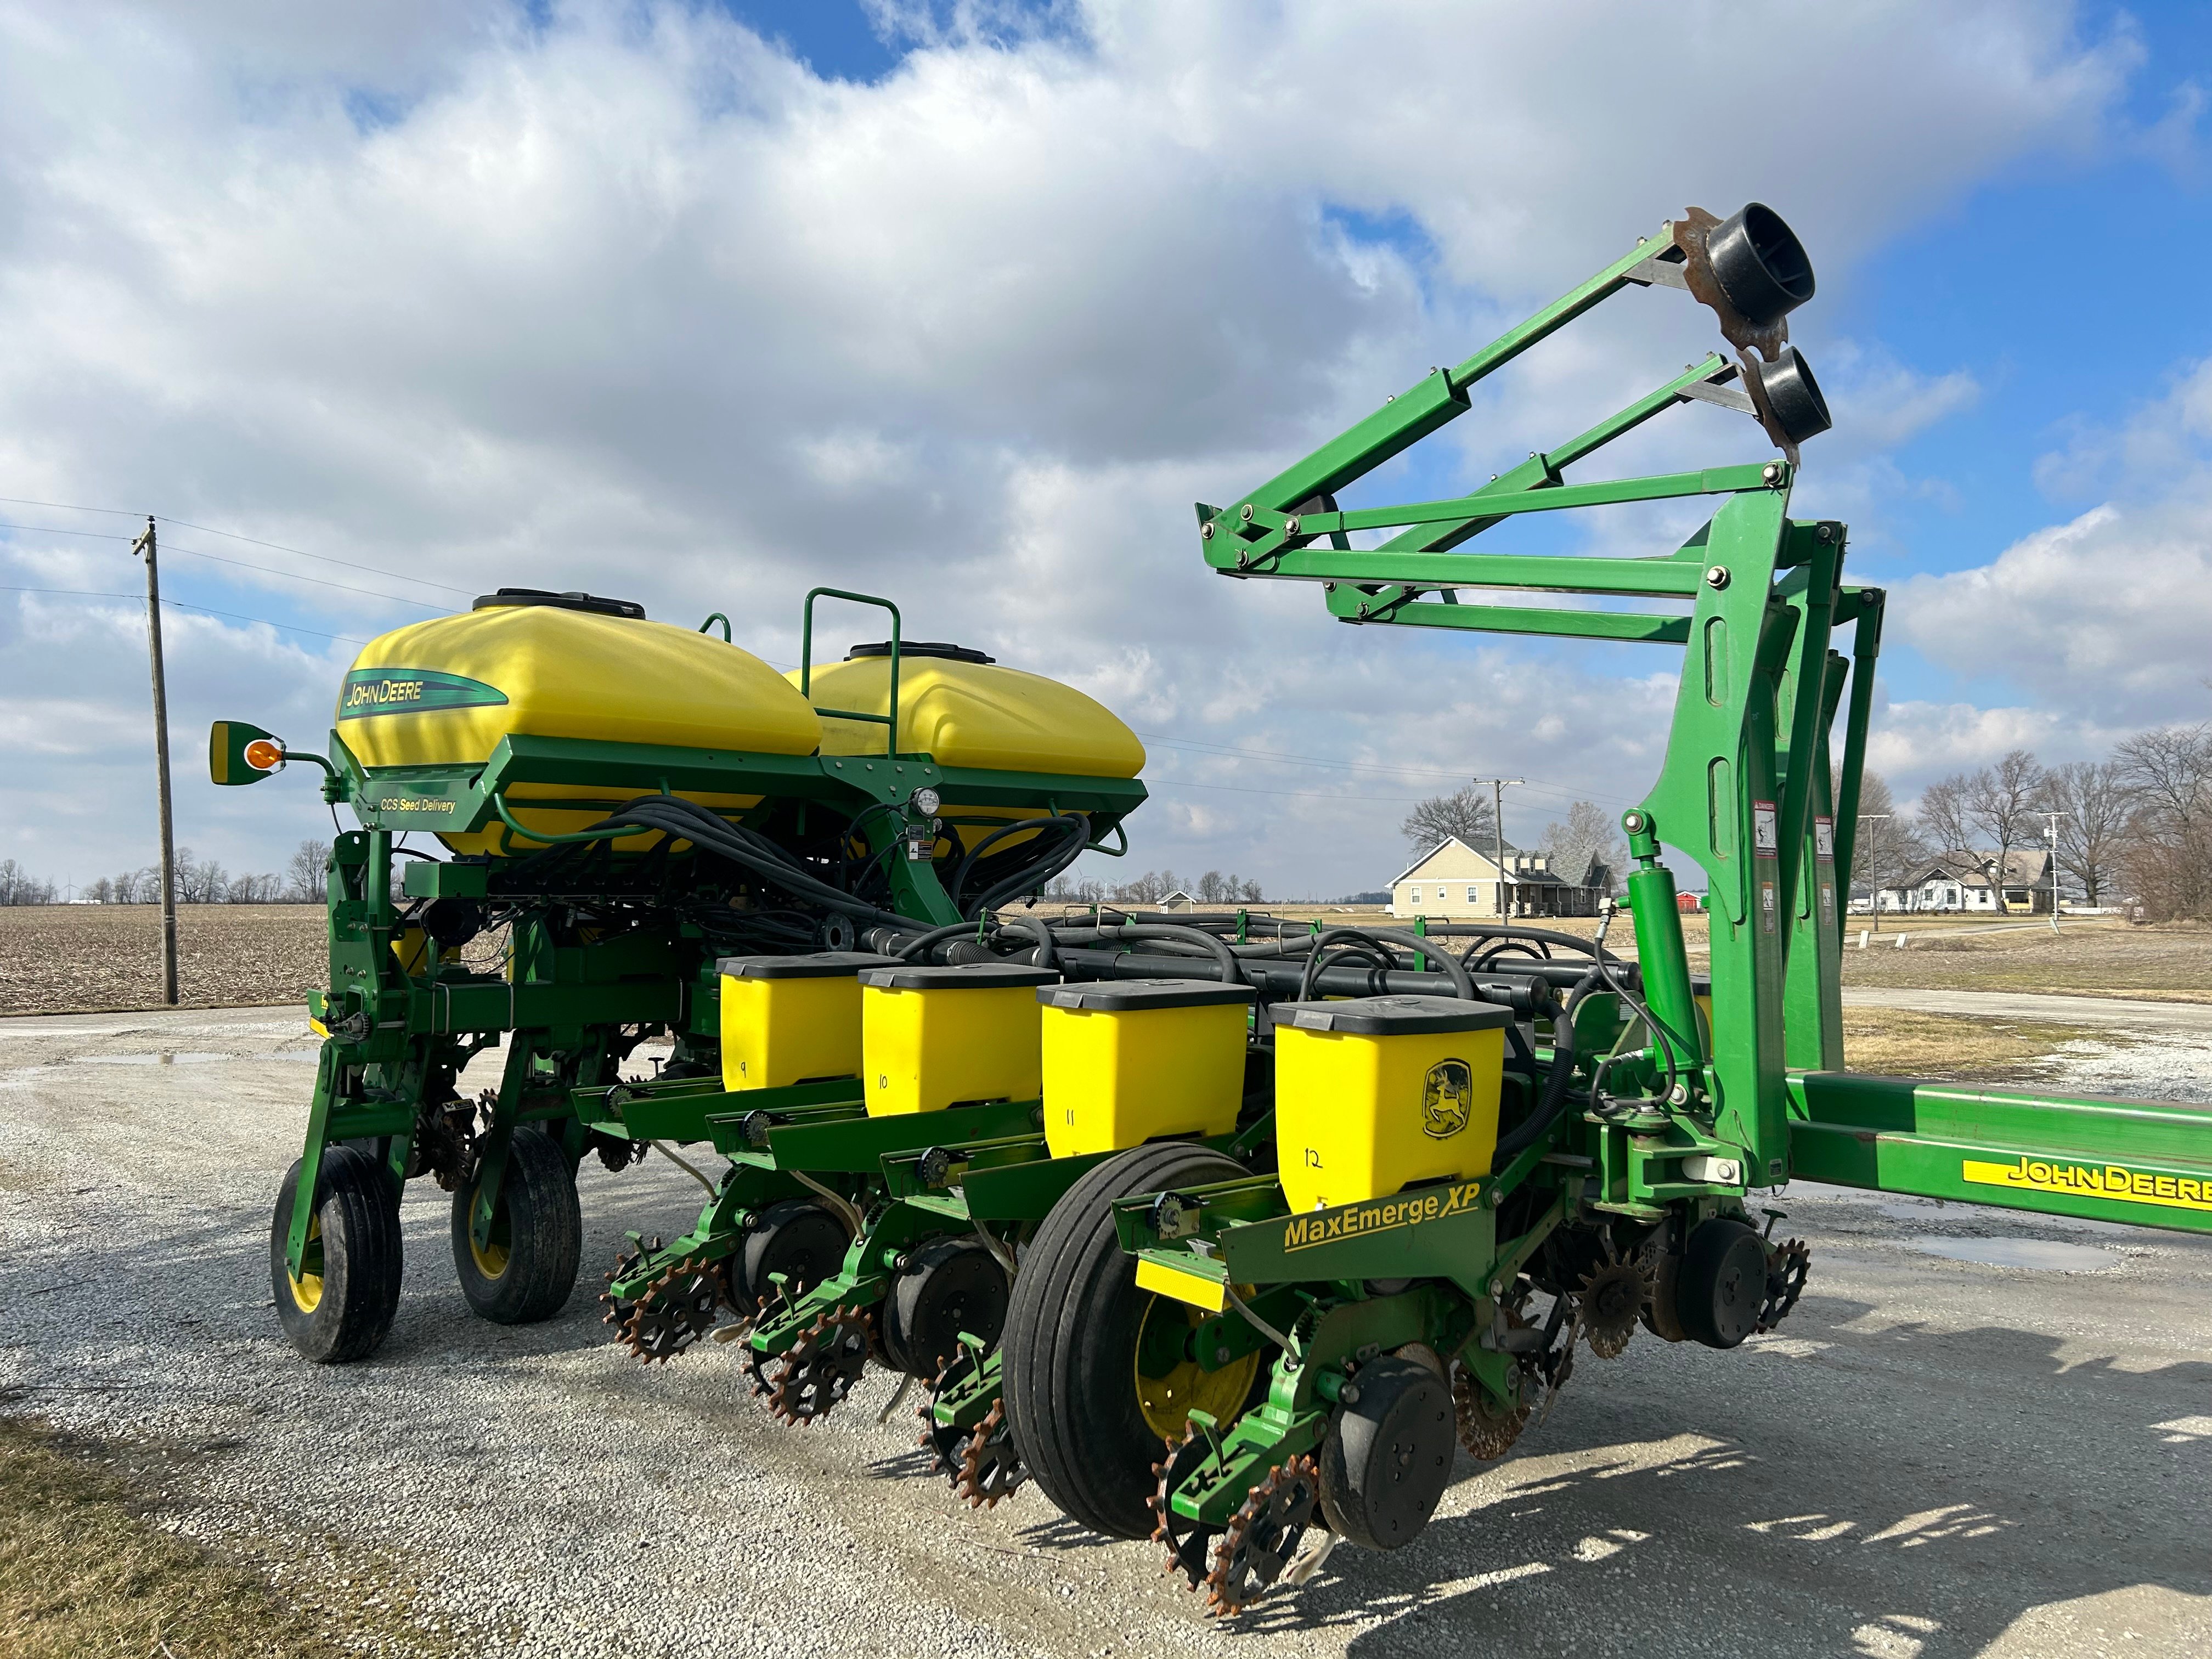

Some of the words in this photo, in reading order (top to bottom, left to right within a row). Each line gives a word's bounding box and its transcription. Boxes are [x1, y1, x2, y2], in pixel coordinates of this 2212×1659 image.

[347, 683, 380, 707] JOHN
[379, 680, 424, 703] DEERE
[381, 798, 398, 811] CCS
[399, 798, 421, 811] Seed
[422, 799, 456, 814] Delivery
[741, 1062, 747, 1079] 9
[879, 1074, 888, 1090] 10
[1066, 1109, 1074, 1126] 11
[1305, 1148, 1323, 1169] 12
[2008, 1156, 2098, 1189] JOHN
[1285, 1195, 1438, 1247] MaxEmerge
[1438, 1183, 1480, 1218] XP
